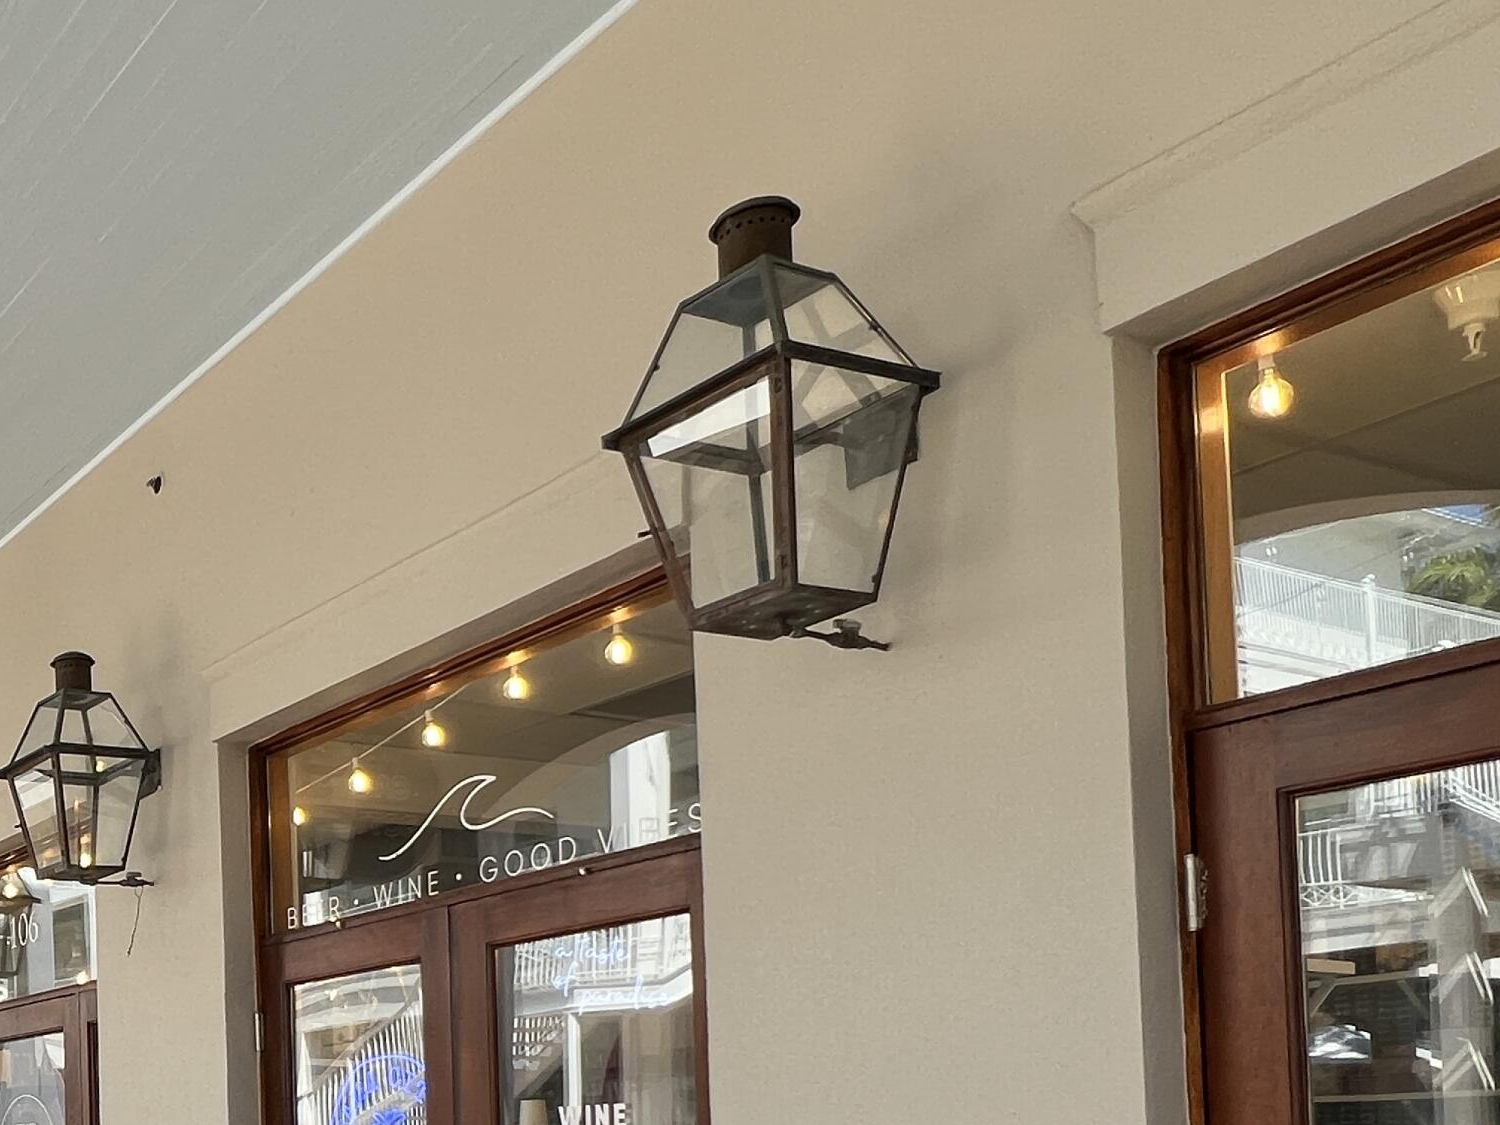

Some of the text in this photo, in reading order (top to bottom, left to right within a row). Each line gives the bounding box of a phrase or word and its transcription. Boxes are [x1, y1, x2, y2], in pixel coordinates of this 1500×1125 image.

[373, 870, 440, 910] WINE
[478, 836, 578, 884] GOOD
[11, 908, 39, 949] 106
